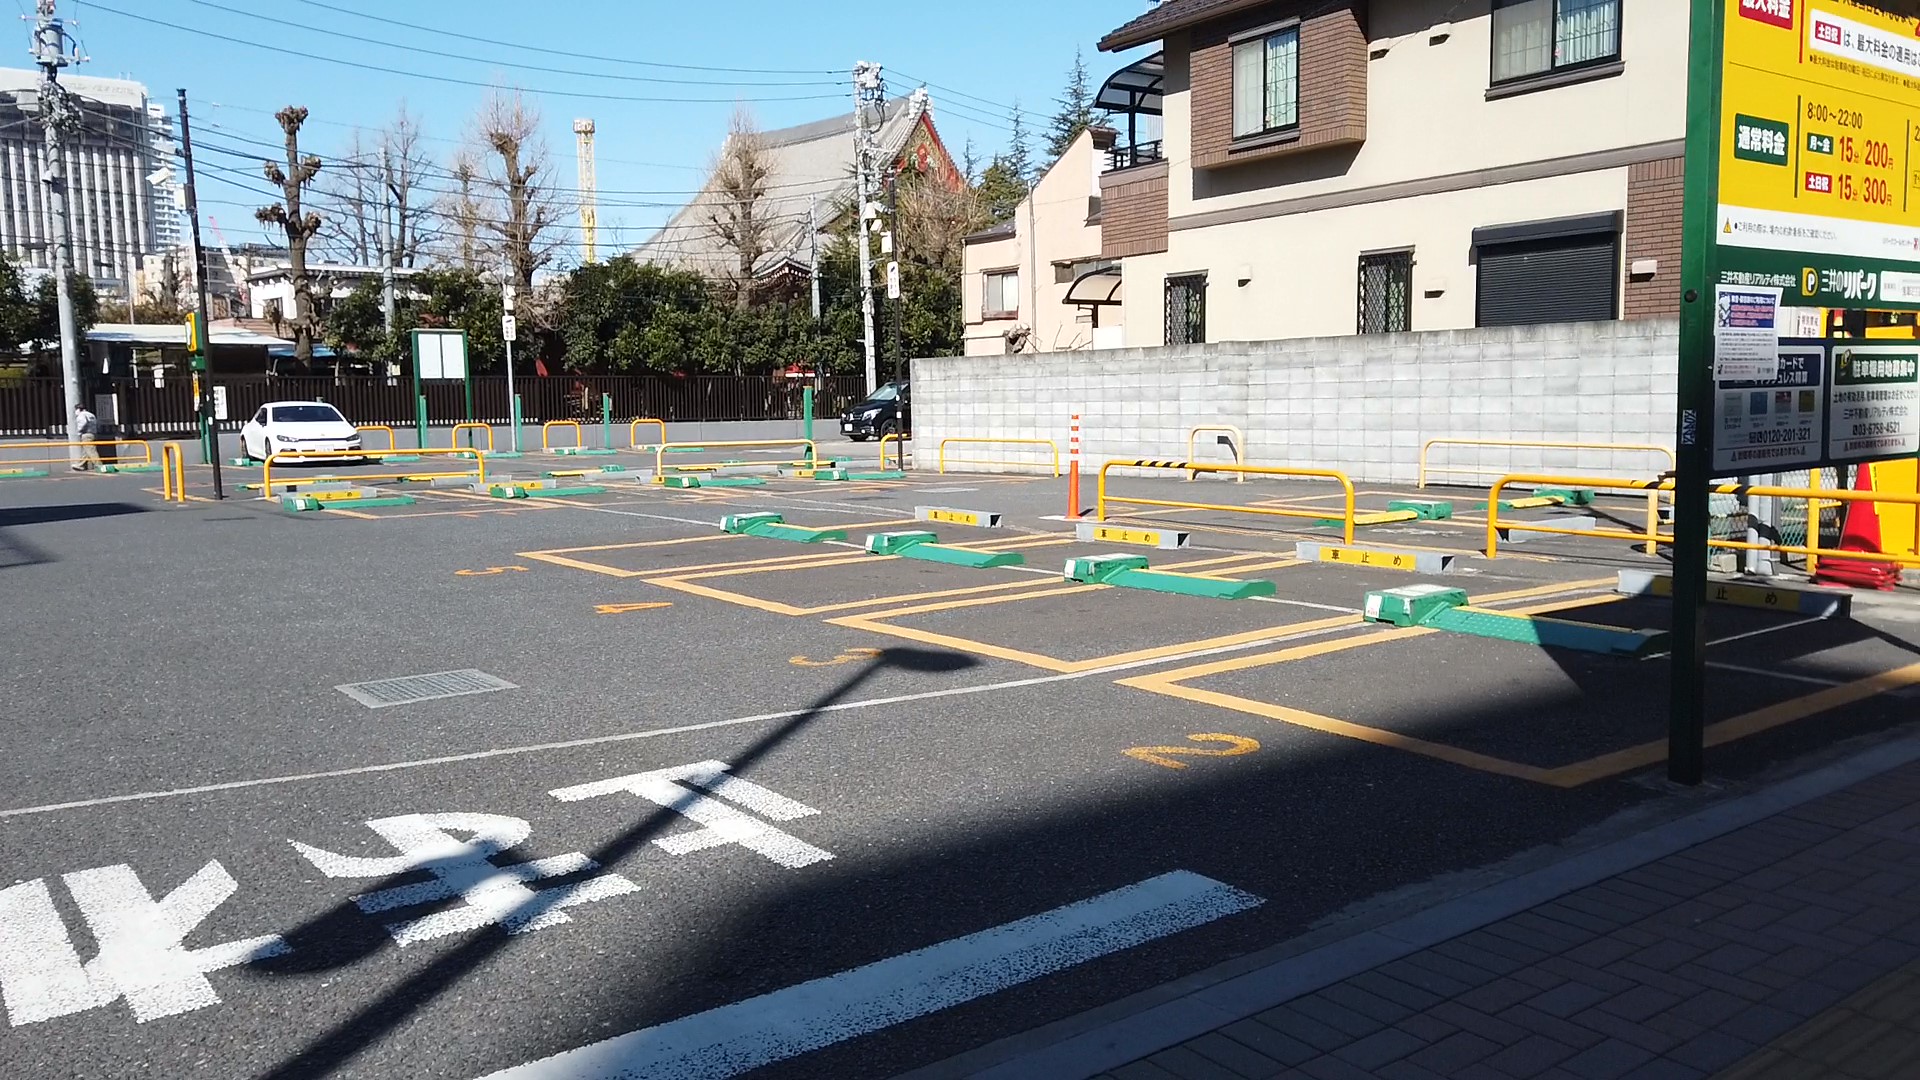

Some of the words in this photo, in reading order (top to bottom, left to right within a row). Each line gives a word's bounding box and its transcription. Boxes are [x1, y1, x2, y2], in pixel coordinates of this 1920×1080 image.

[1738, 125, 1785, 156] 通常料金
[1808, 176, 1830, 192] 土日祝
[1720, 271, 1797, 287] 三井不動産リアルティ株式会社
[1820, 268, 1877, 300] 三井のリパーク
[1853, 359, 1916, 378] 駐車場用地募集中
[1763, 427, 1811, 444] 0120-201-321
[1330, 549, 1402, 566] 車止め
[1121, 732, 1261, 770] 2
